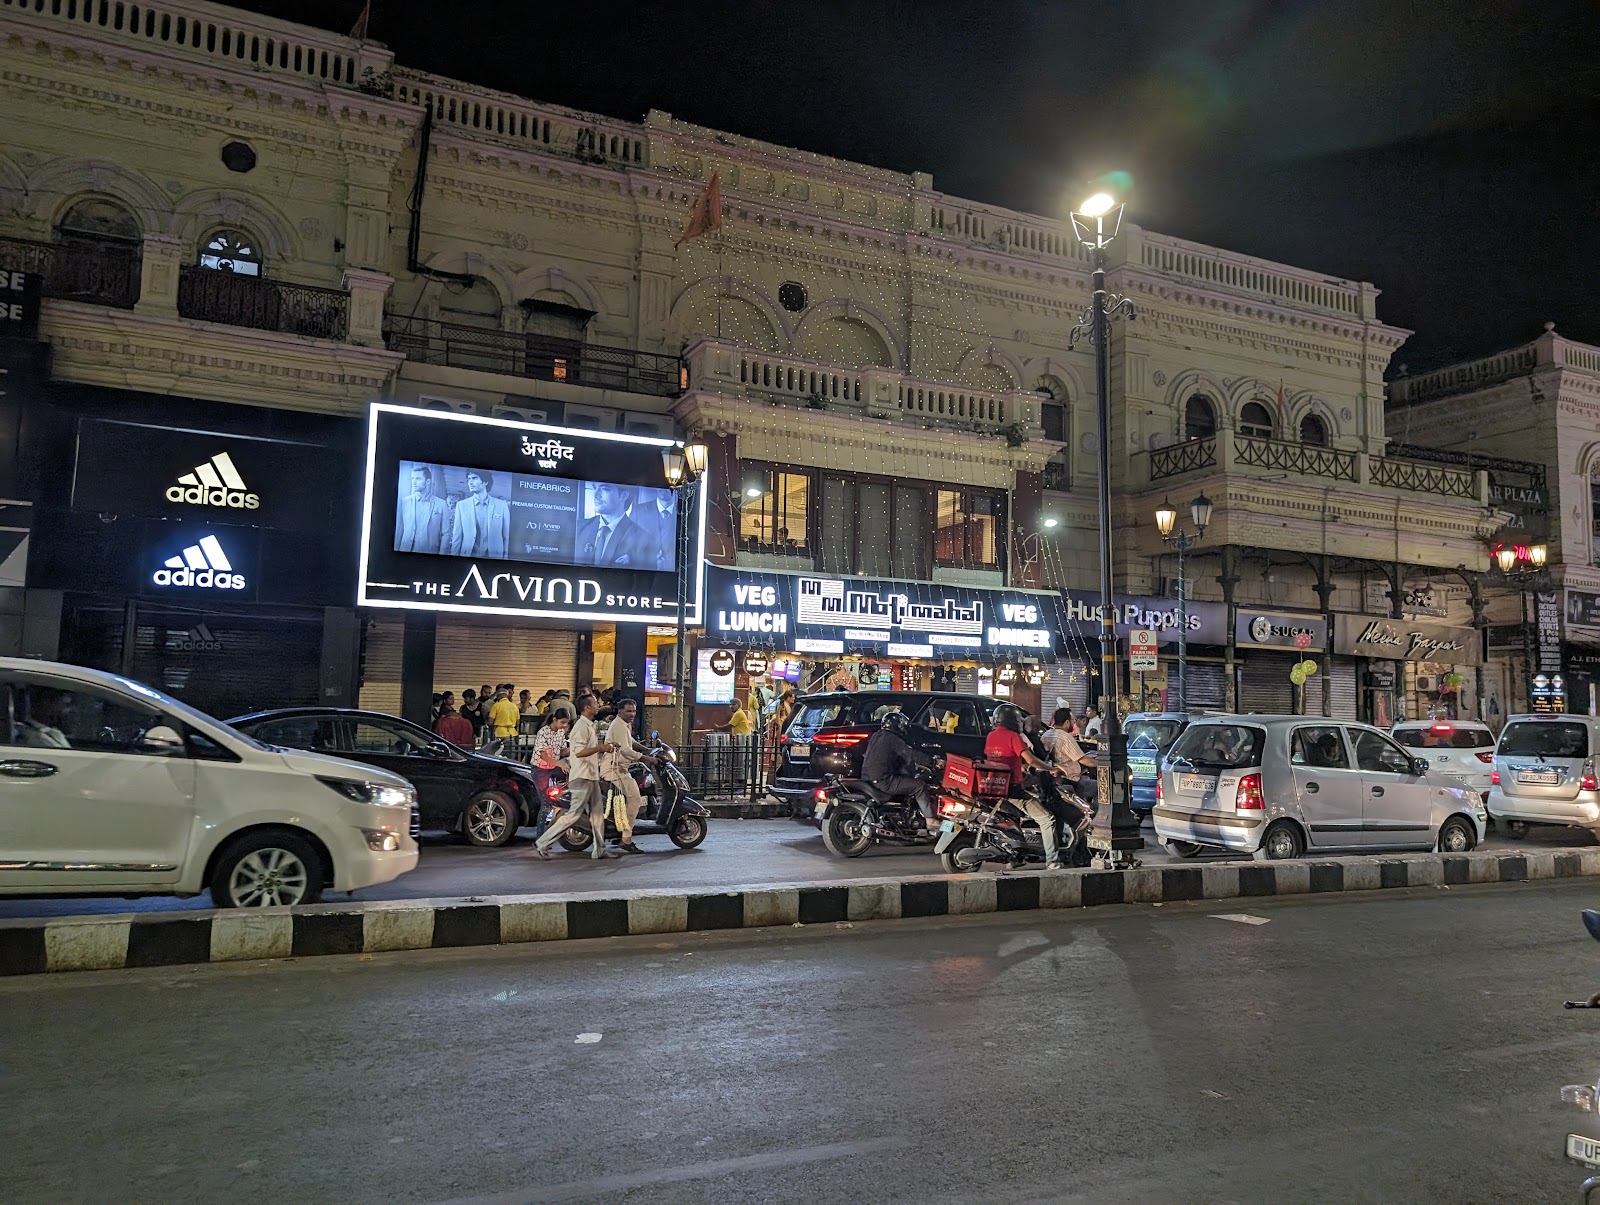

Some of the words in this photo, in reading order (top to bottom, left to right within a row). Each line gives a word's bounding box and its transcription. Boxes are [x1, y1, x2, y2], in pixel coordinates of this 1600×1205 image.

[521, 439, 575, 461] अरविंद
[165, 484, 260, 510] adidas
[534, 502, 553, 510] CUSTOM
[1504, 487, 1541, 504] PLAZA
[153, 566, 246, 590] adidas
[413, 581, 451, 596] THE
[606, 594, 663, 609] STORE
[734, 585, 776, 606] VEG
[719, 611, 787, 633] LUNCH
[1002, 603, 1038, 623] VEG
[175, 639, 221, 651] adidas
[988, 627, 1051, 648] DINNER
[1359, 621, 1403, 646] Meena
[1409, 632, 1465, 660] Bazaar
[948, 771, 969, 785] zomato
[981, 776, 1007, 784] zomato
